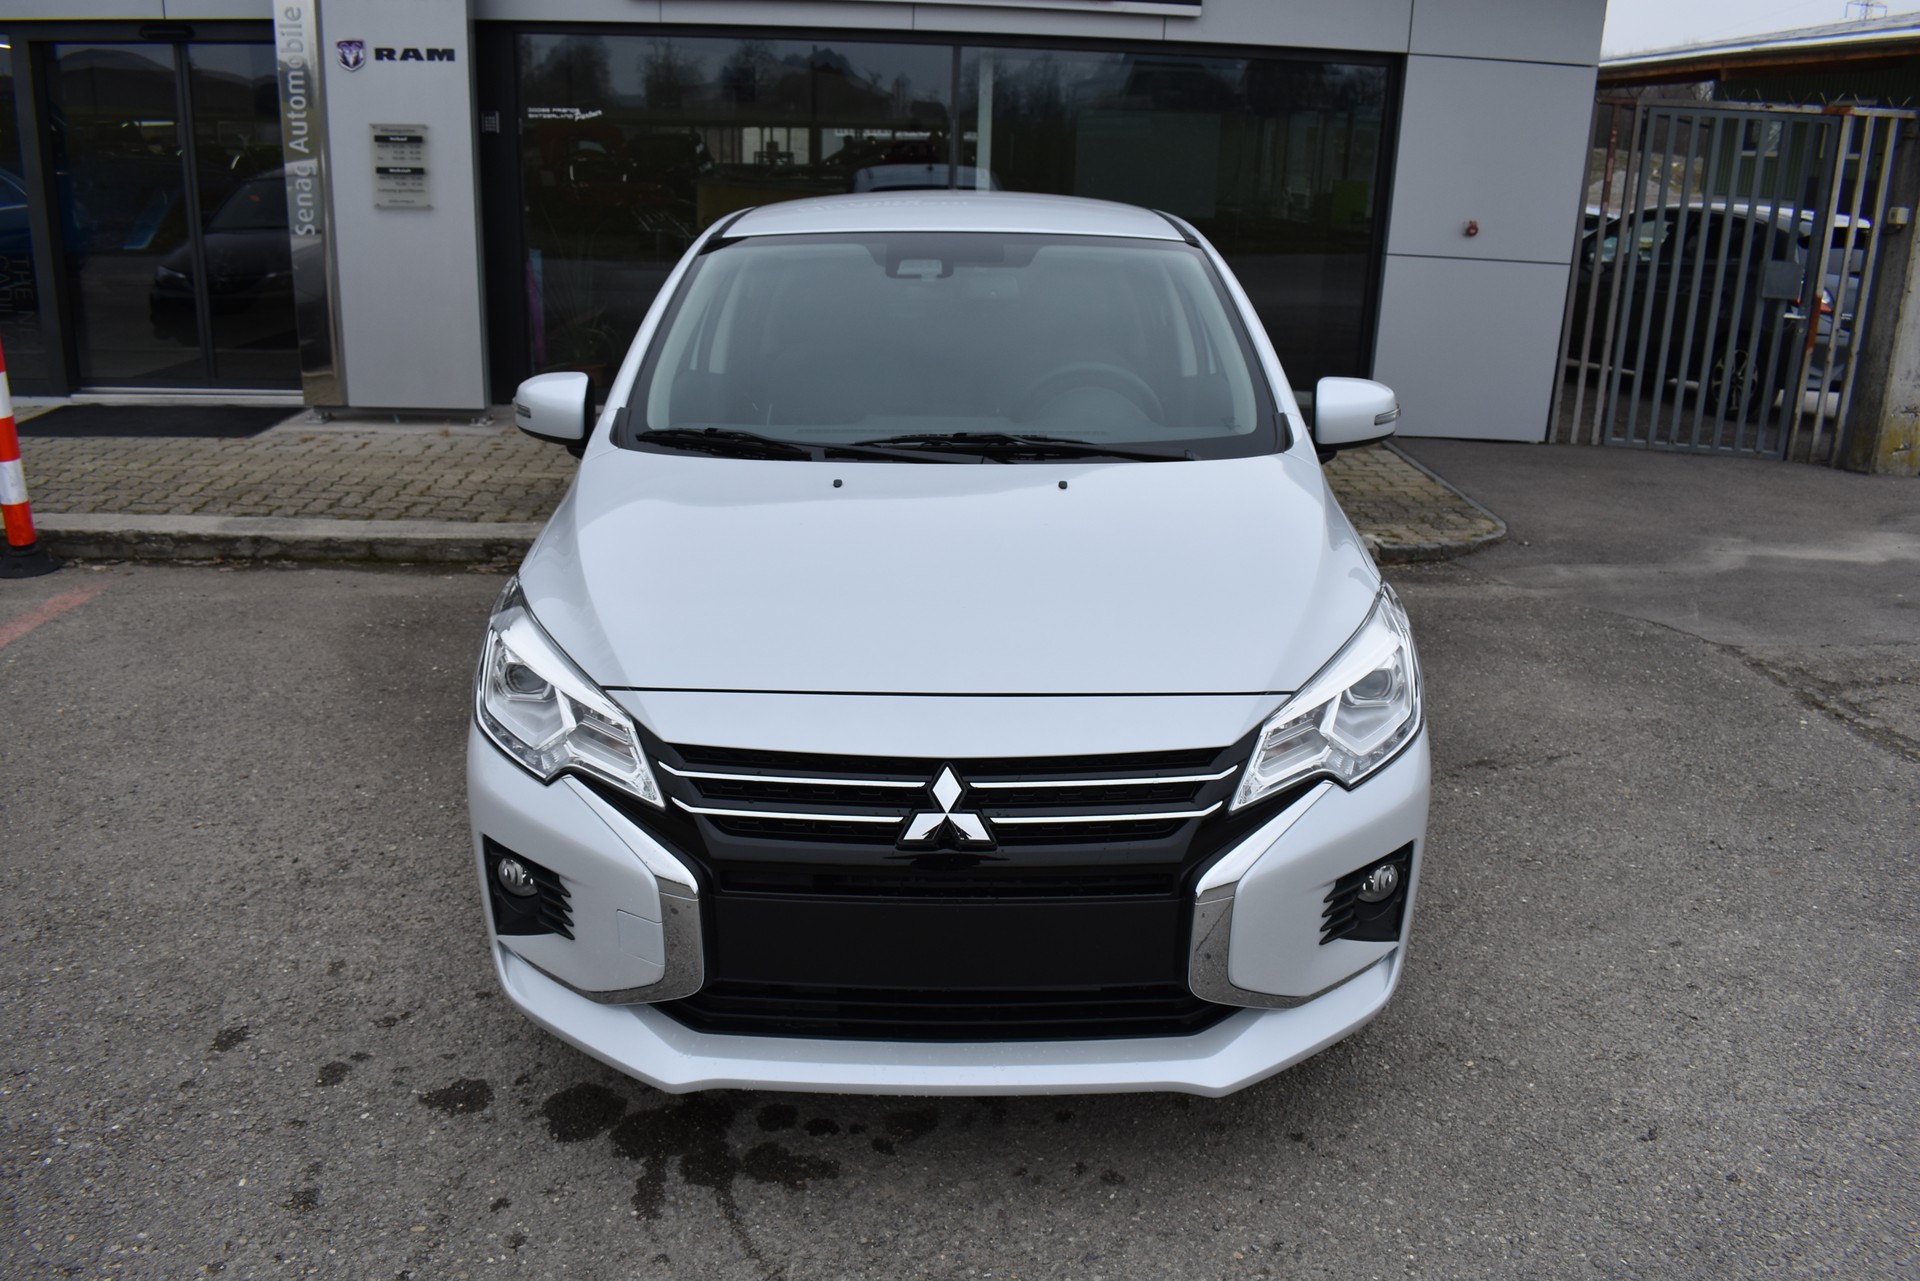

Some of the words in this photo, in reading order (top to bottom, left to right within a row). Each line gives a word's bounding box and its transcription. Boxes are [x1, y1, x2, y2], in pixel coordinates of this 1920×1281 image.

[279, 6, 309, 153] Automobile
[375, 47, 455, 62] RAM
[295, 165, 317, 236] Senag
